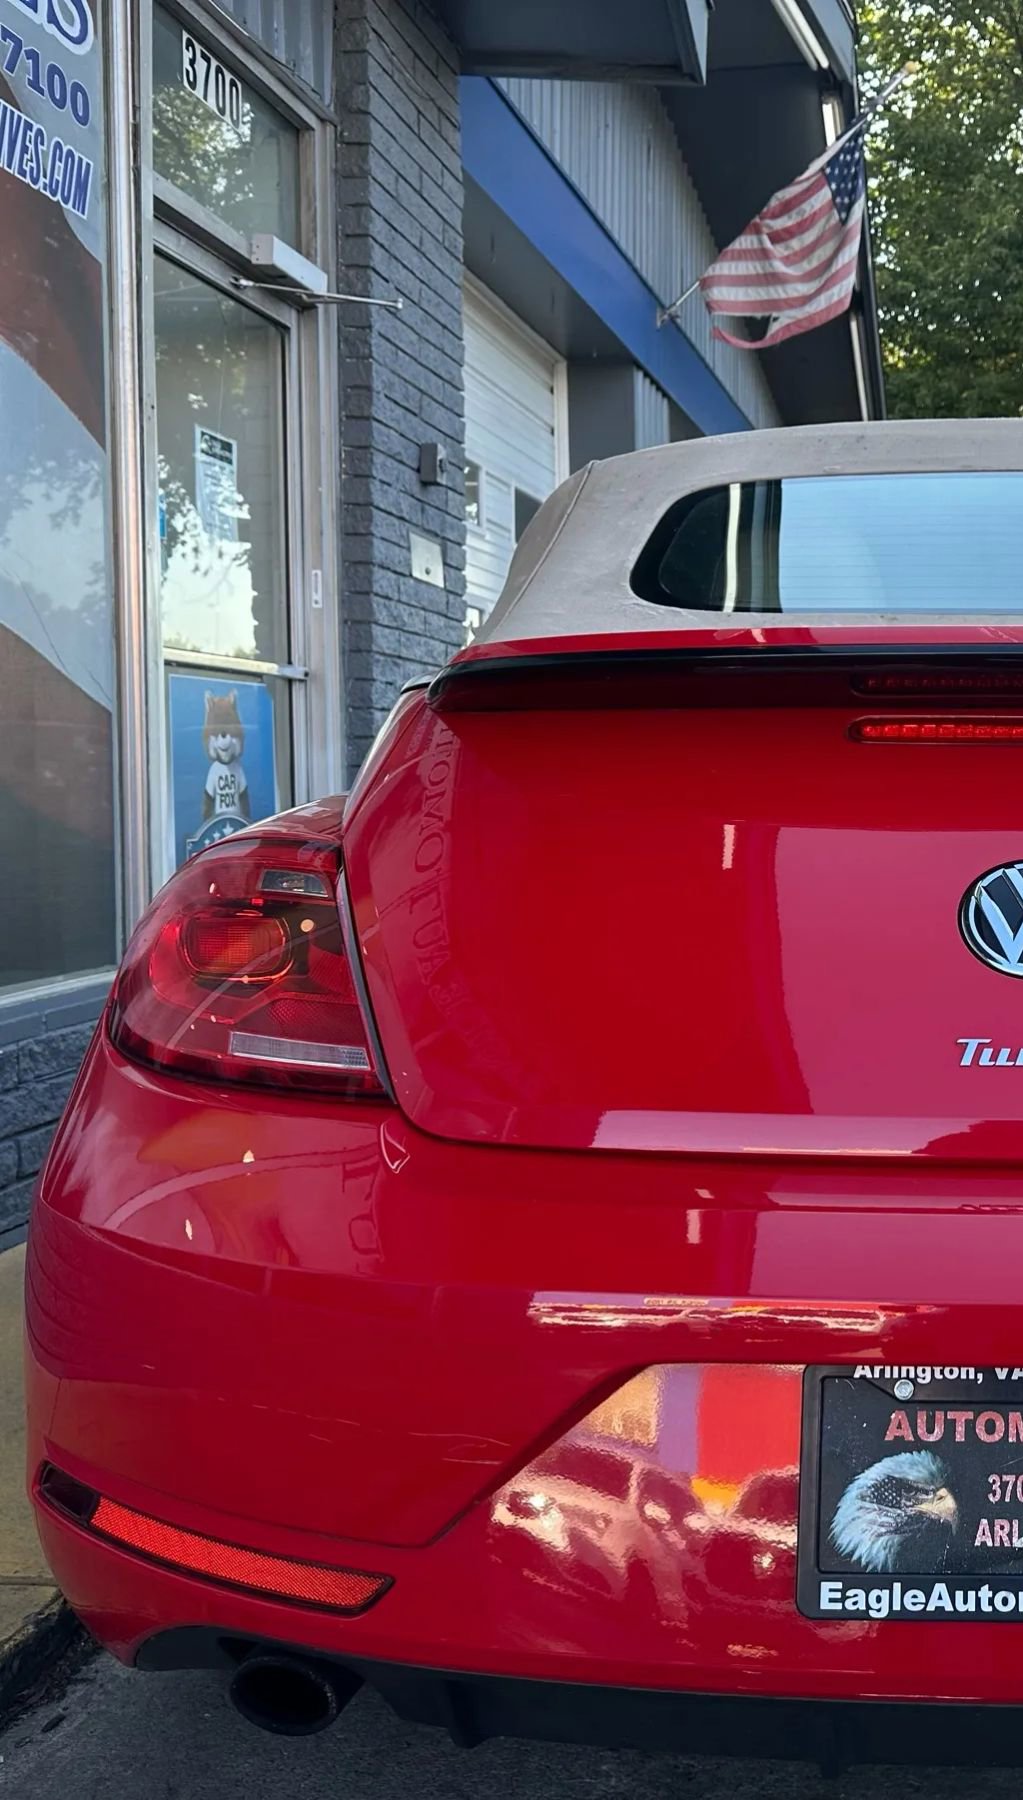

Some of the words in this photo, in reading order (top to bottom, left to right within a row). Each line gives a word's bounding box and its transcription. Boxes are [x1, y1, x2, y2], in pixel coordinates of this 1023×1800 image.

[1, 24, 90, 127] 7100
[184, 36, 241, 130] 3700
[218, 774, 237, 791] CAR
[219, 793, 236, 808] FOX
